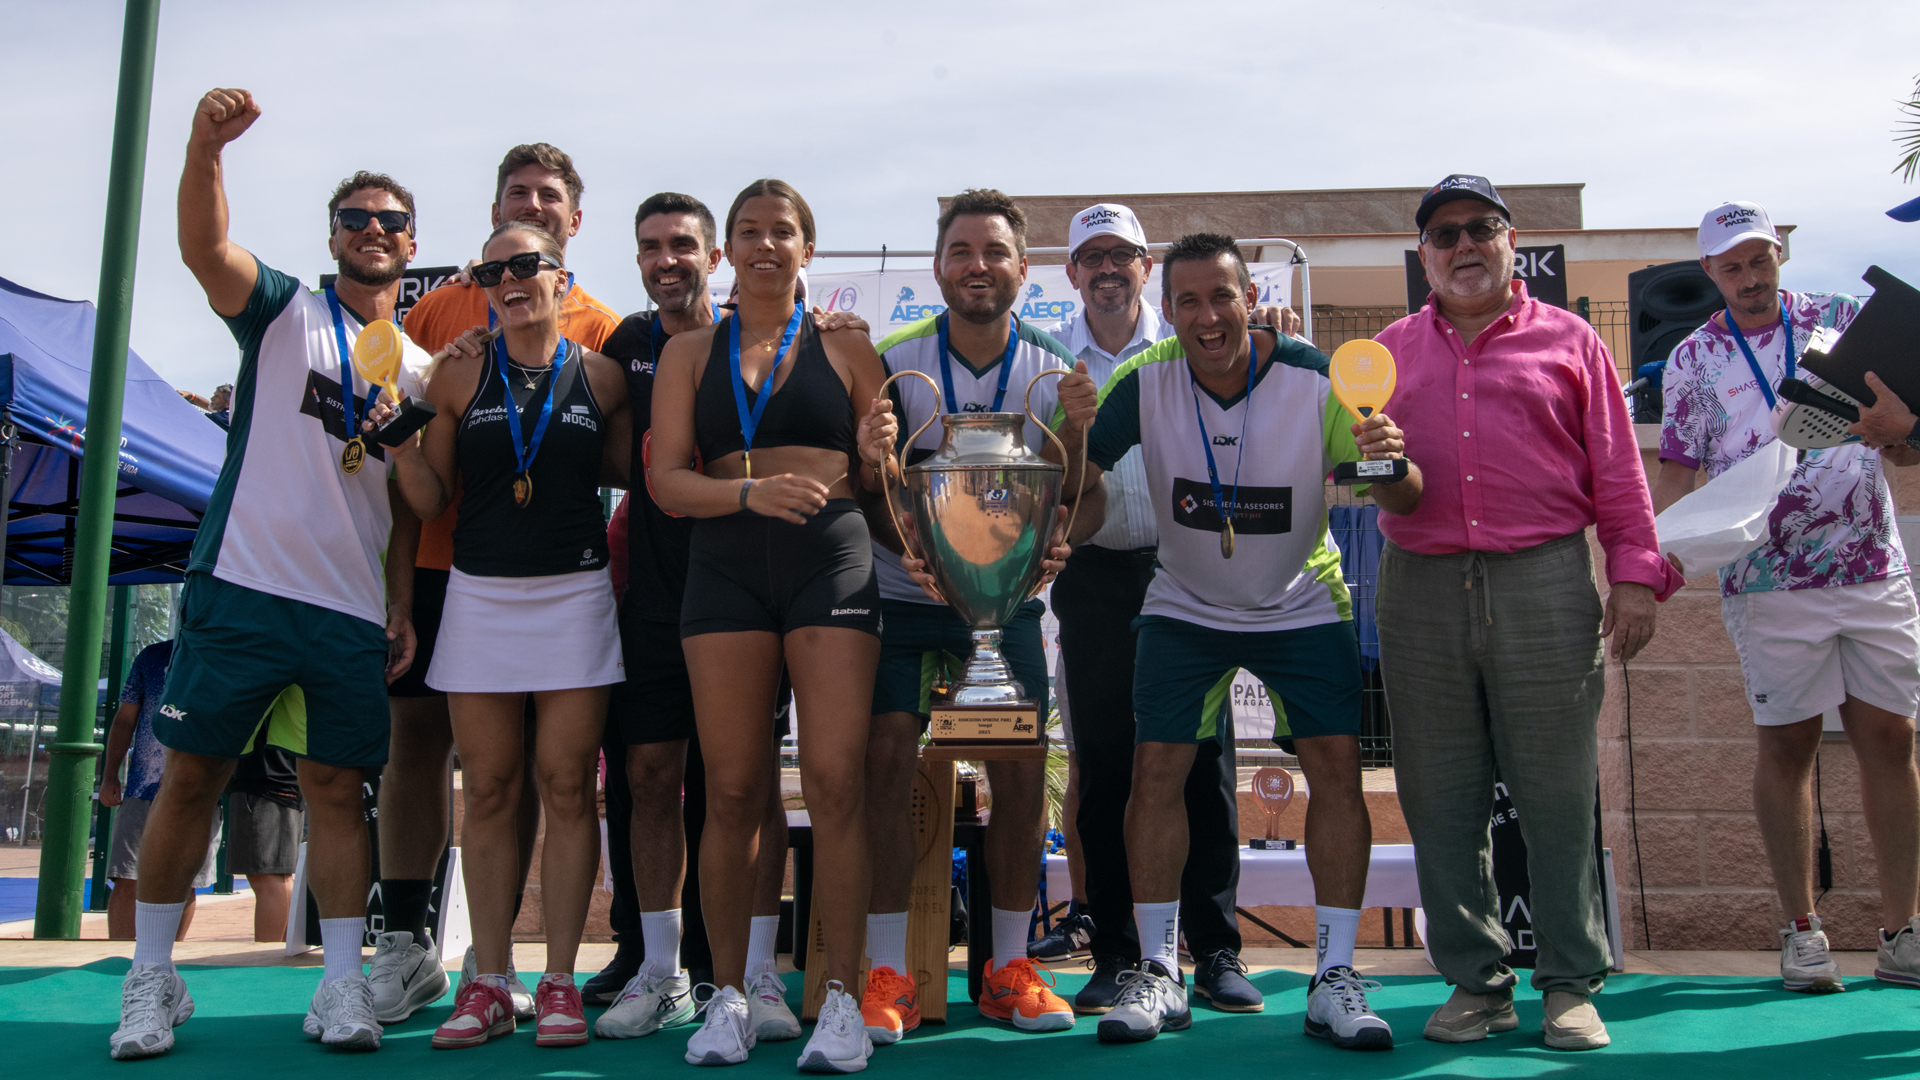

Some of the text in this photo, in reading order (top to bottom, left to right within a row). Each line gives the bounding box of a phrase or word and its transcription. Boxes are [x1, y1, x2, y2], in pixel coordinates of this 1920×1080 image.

[1081, 210, 1121, 225] SHARK
[1087, 218, 1114, 228] PADEL
[1716, 210, 1757, 225] SHARK
[1725, 218, 1753, 228] PADEL
[1019, 301, 1075, 321] AECP
[1728, 380, 1760, 397] SHAR
[562, 412, 597, 432] NOCCO
[123, 463, 138, 475] VIDA
[1244, 502, 1284, 510] ASESORES
